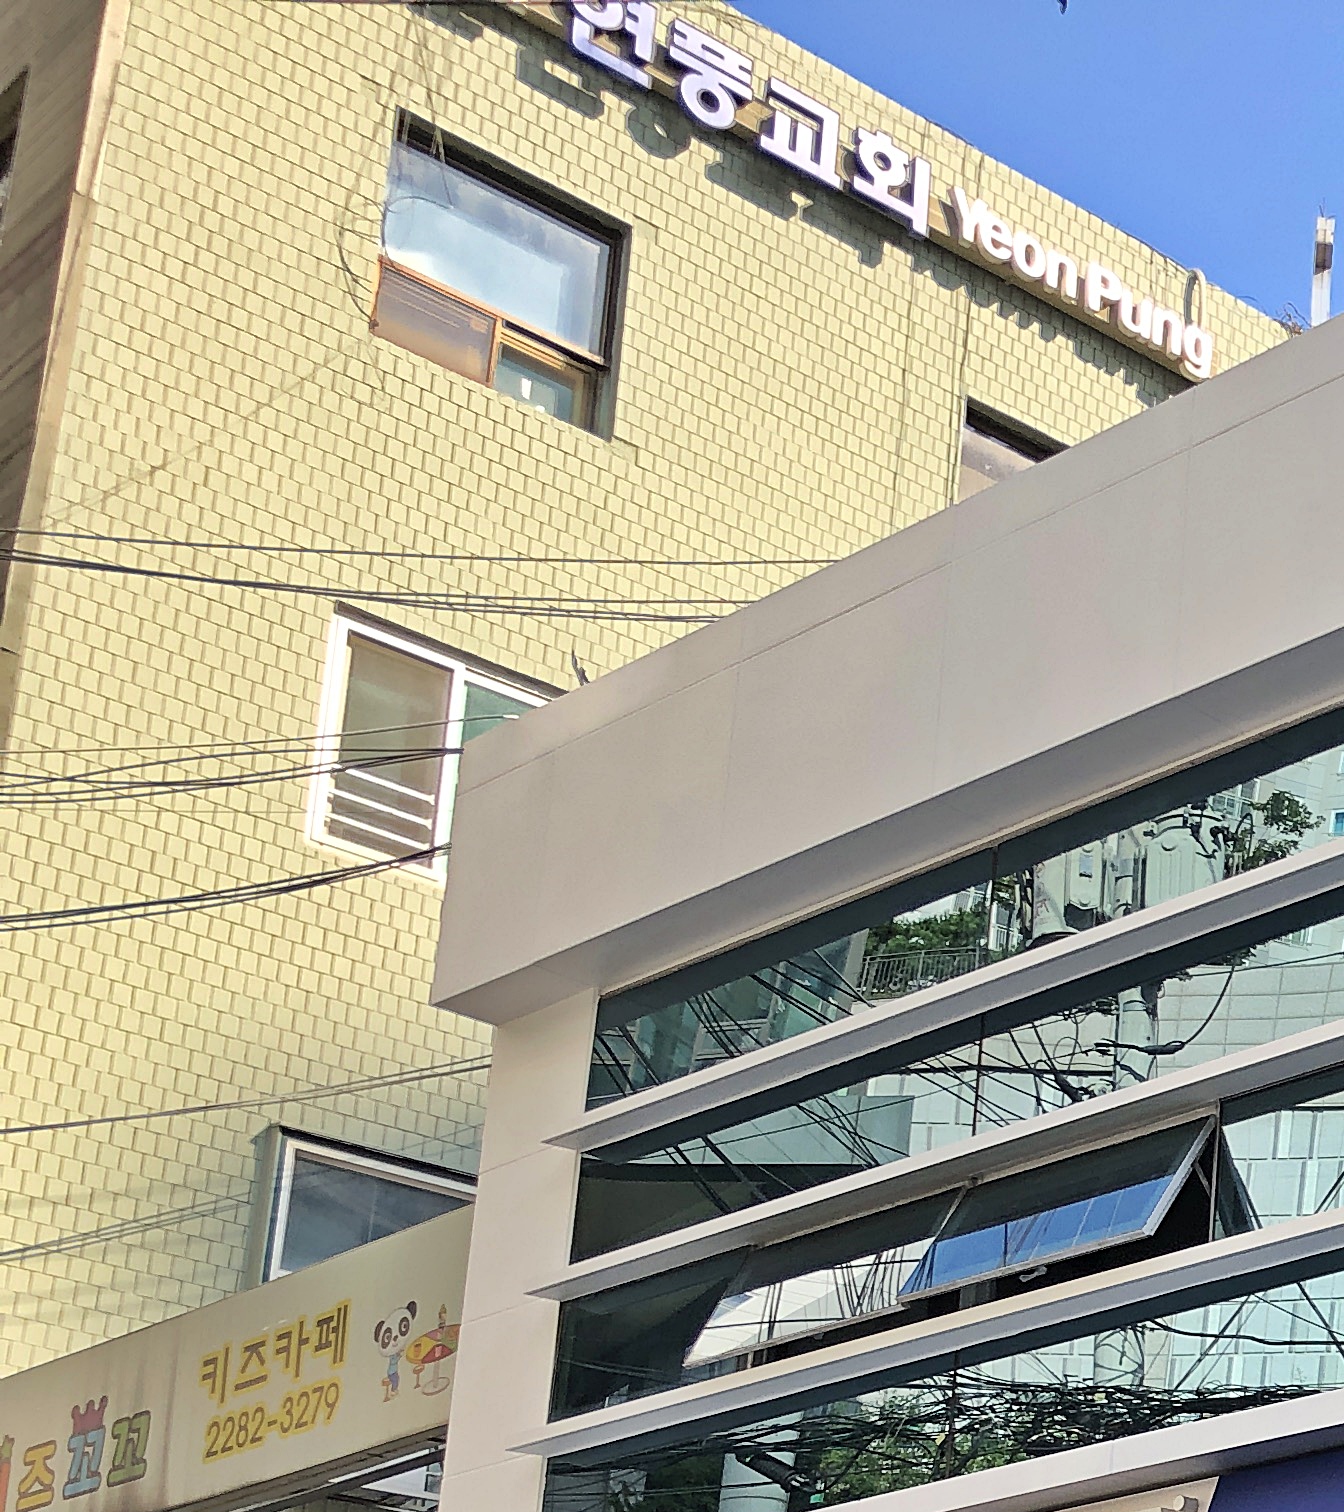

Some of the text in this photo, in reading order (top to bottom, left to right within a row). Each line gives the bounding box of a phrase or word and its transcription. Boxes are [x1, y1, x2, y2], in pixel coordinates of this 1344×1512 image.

[572, 0, 1213, 380] 연풍교회 Yeon Pung
[201, 1301, 350, 1402] 키즈카페
[204, 1381, 341, 1460] 2282-3279
